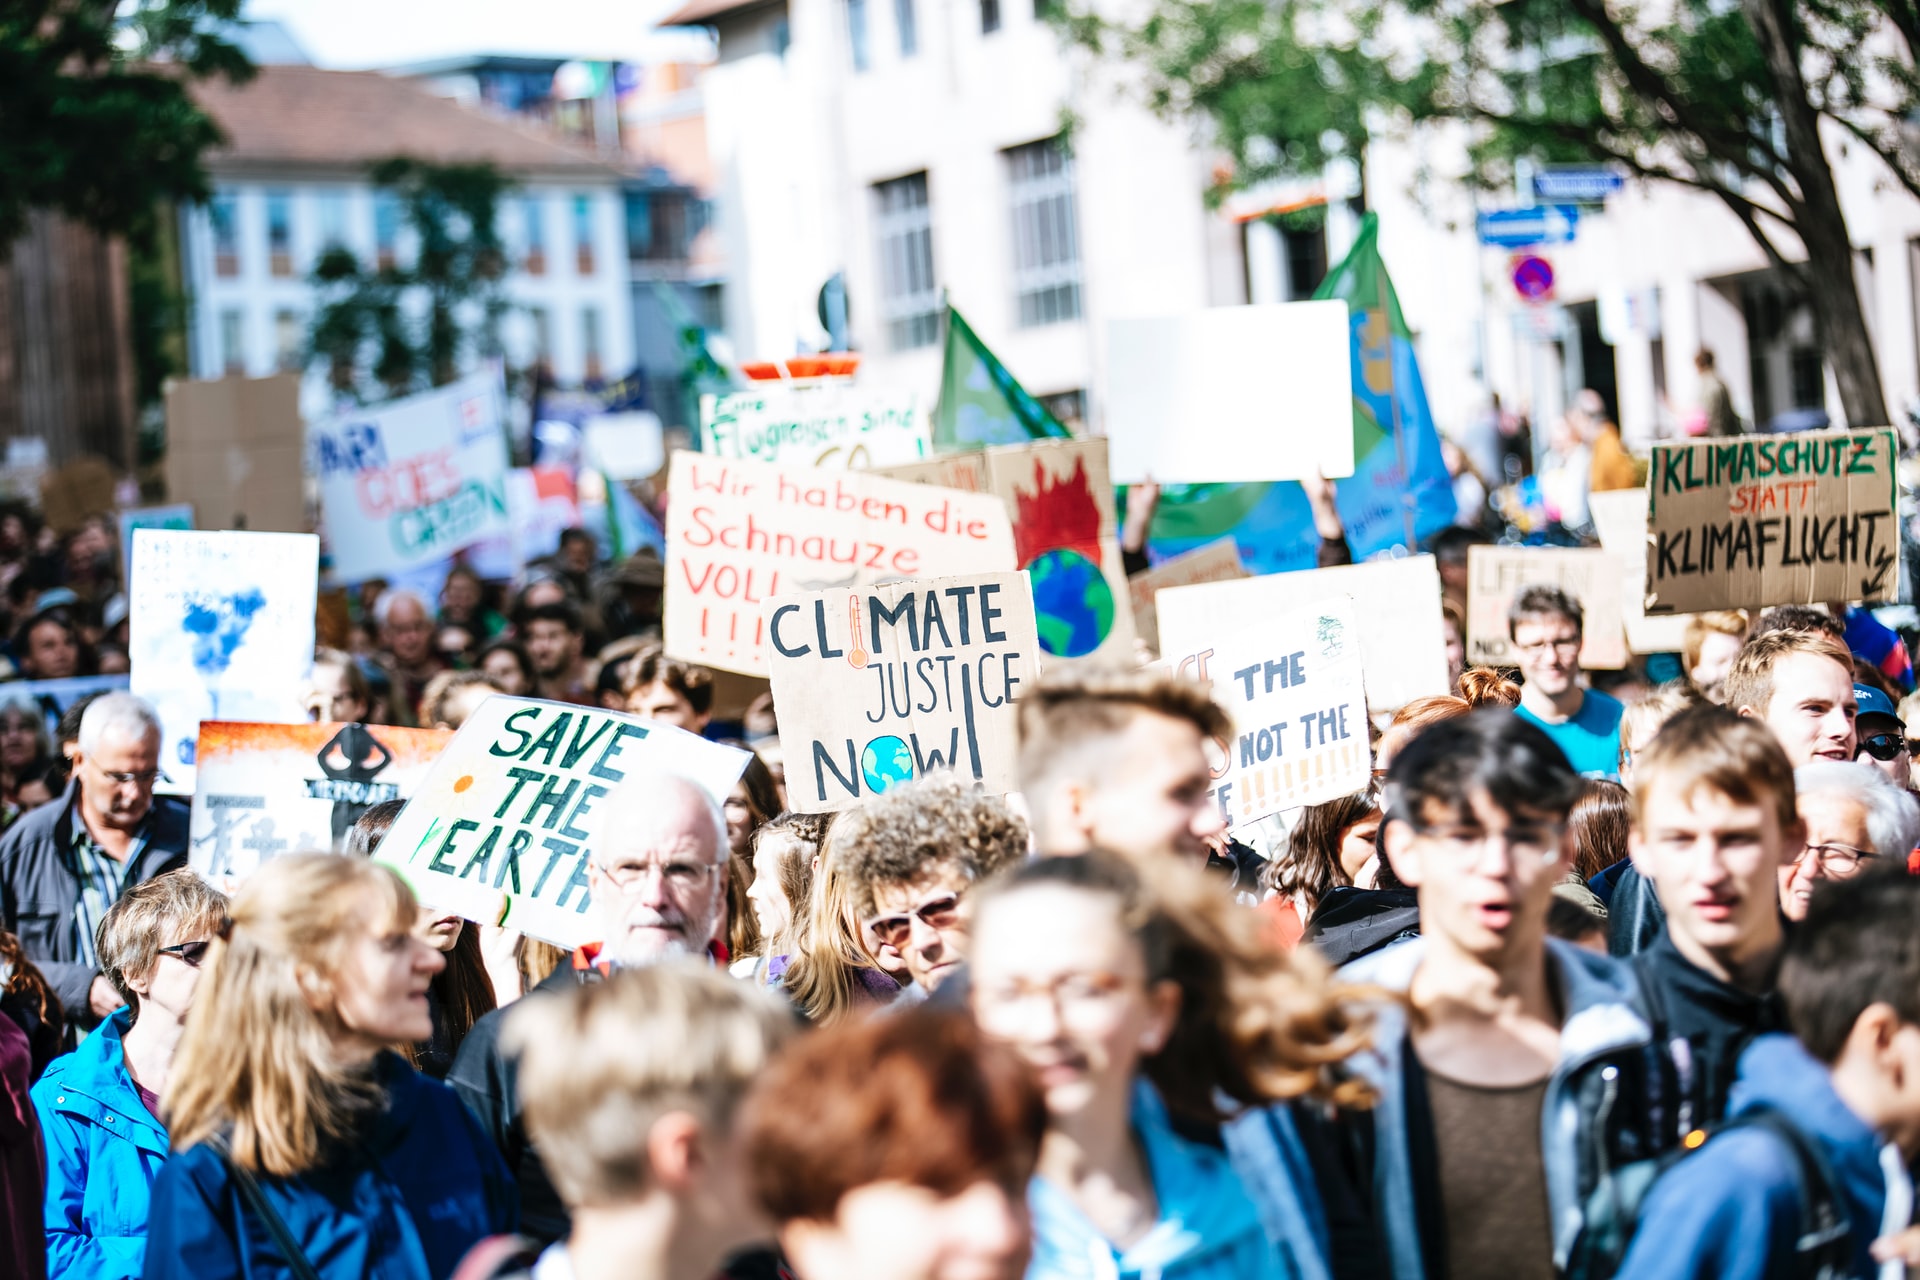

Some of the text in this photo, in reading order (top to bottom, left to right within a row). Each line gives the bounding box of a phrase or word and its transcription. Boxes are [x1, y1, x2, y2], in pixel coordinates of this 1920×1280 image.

[1663, 437, 1877, 495] KLIMASCHUTZ
[1729, 481, 1817, 514] STATT
[691, 465, 754, 496] Wir
[777, 473, 909, 525] haben
[923, 499, 990, 540] die
[682, 506, 920, 575] Schnauze
[1656, 511, 1890, 579] KLIMAFLUCHT
[770, 583, 1007, 669] CLIMATE
[866, 652, 1021, 740] JUSTICE
[1233, 650, 1307, 702] THE
[488, 706, 651, 783] SAVE
[1238, 721, 1288, 769] NOT
[1300, 703, 1351, 750] THE
[492, 766, 611, 842] THE
